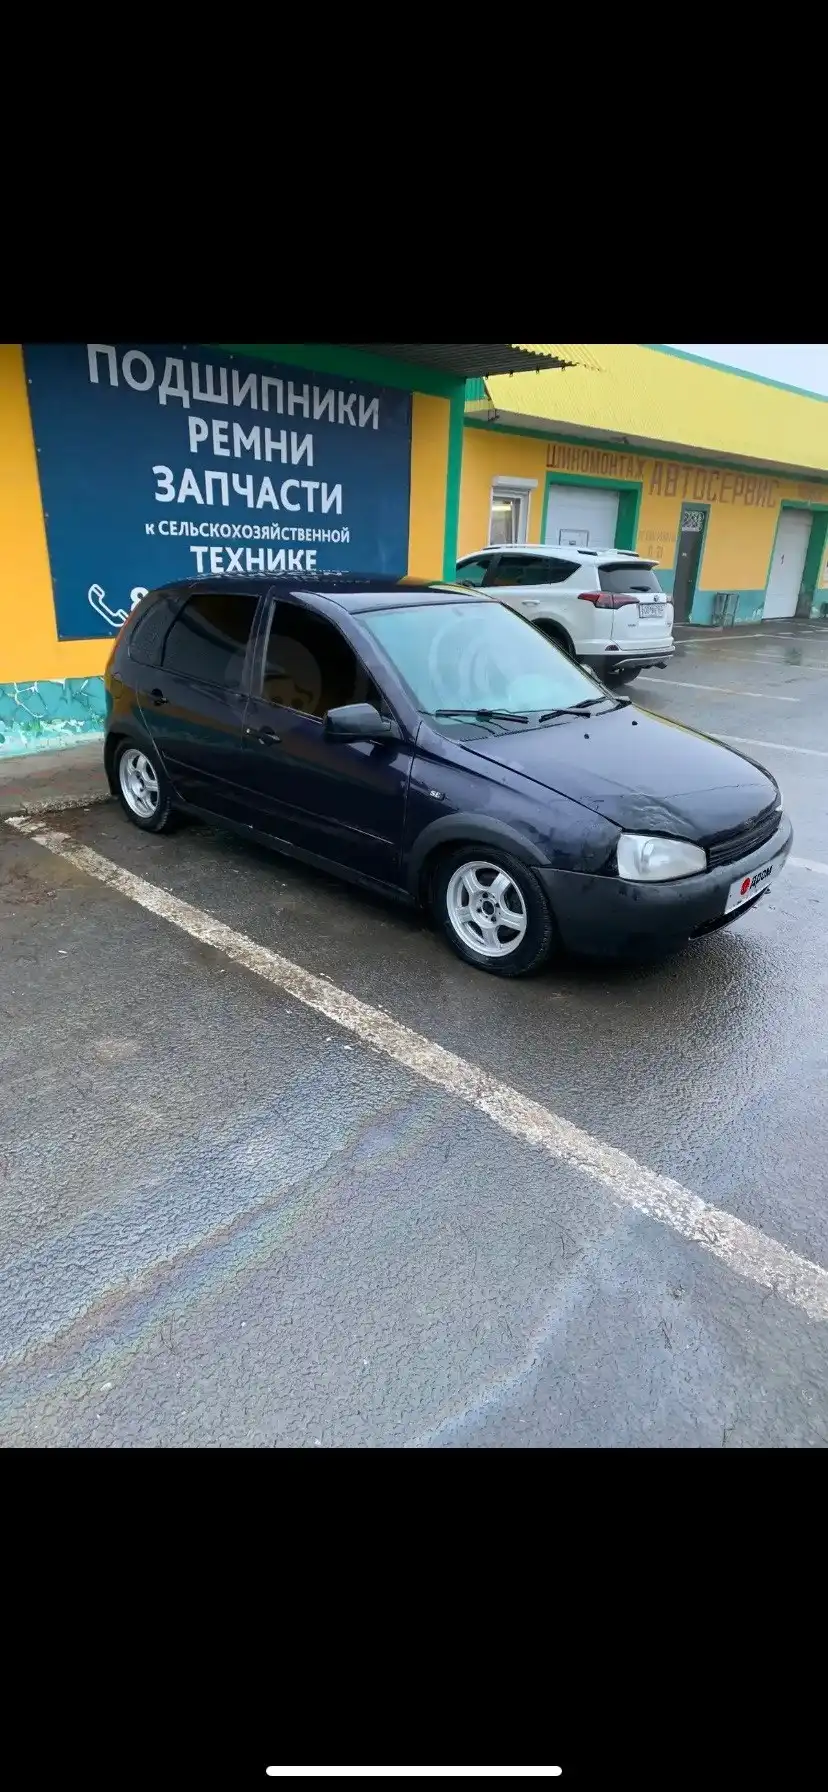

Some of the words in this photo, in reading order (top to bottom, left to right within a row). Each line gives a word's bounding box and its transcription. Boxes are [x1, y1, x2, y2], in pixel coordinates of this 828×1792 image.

[87, 343, 380, 430] ПОДШИПНИКИ
[188, 416, 314, 467] РЕМНИ
[152, 465, 343, 515] ЗАПЧАСТИ
[648, 459, 780, 508] АВТОСЕРВИС
[158, 520, 350, 543] СЕЛЬСКОХОЗЯЙСТВЕННОЙ
[190, 546, 318, 573] ТЕХНИКЕ
